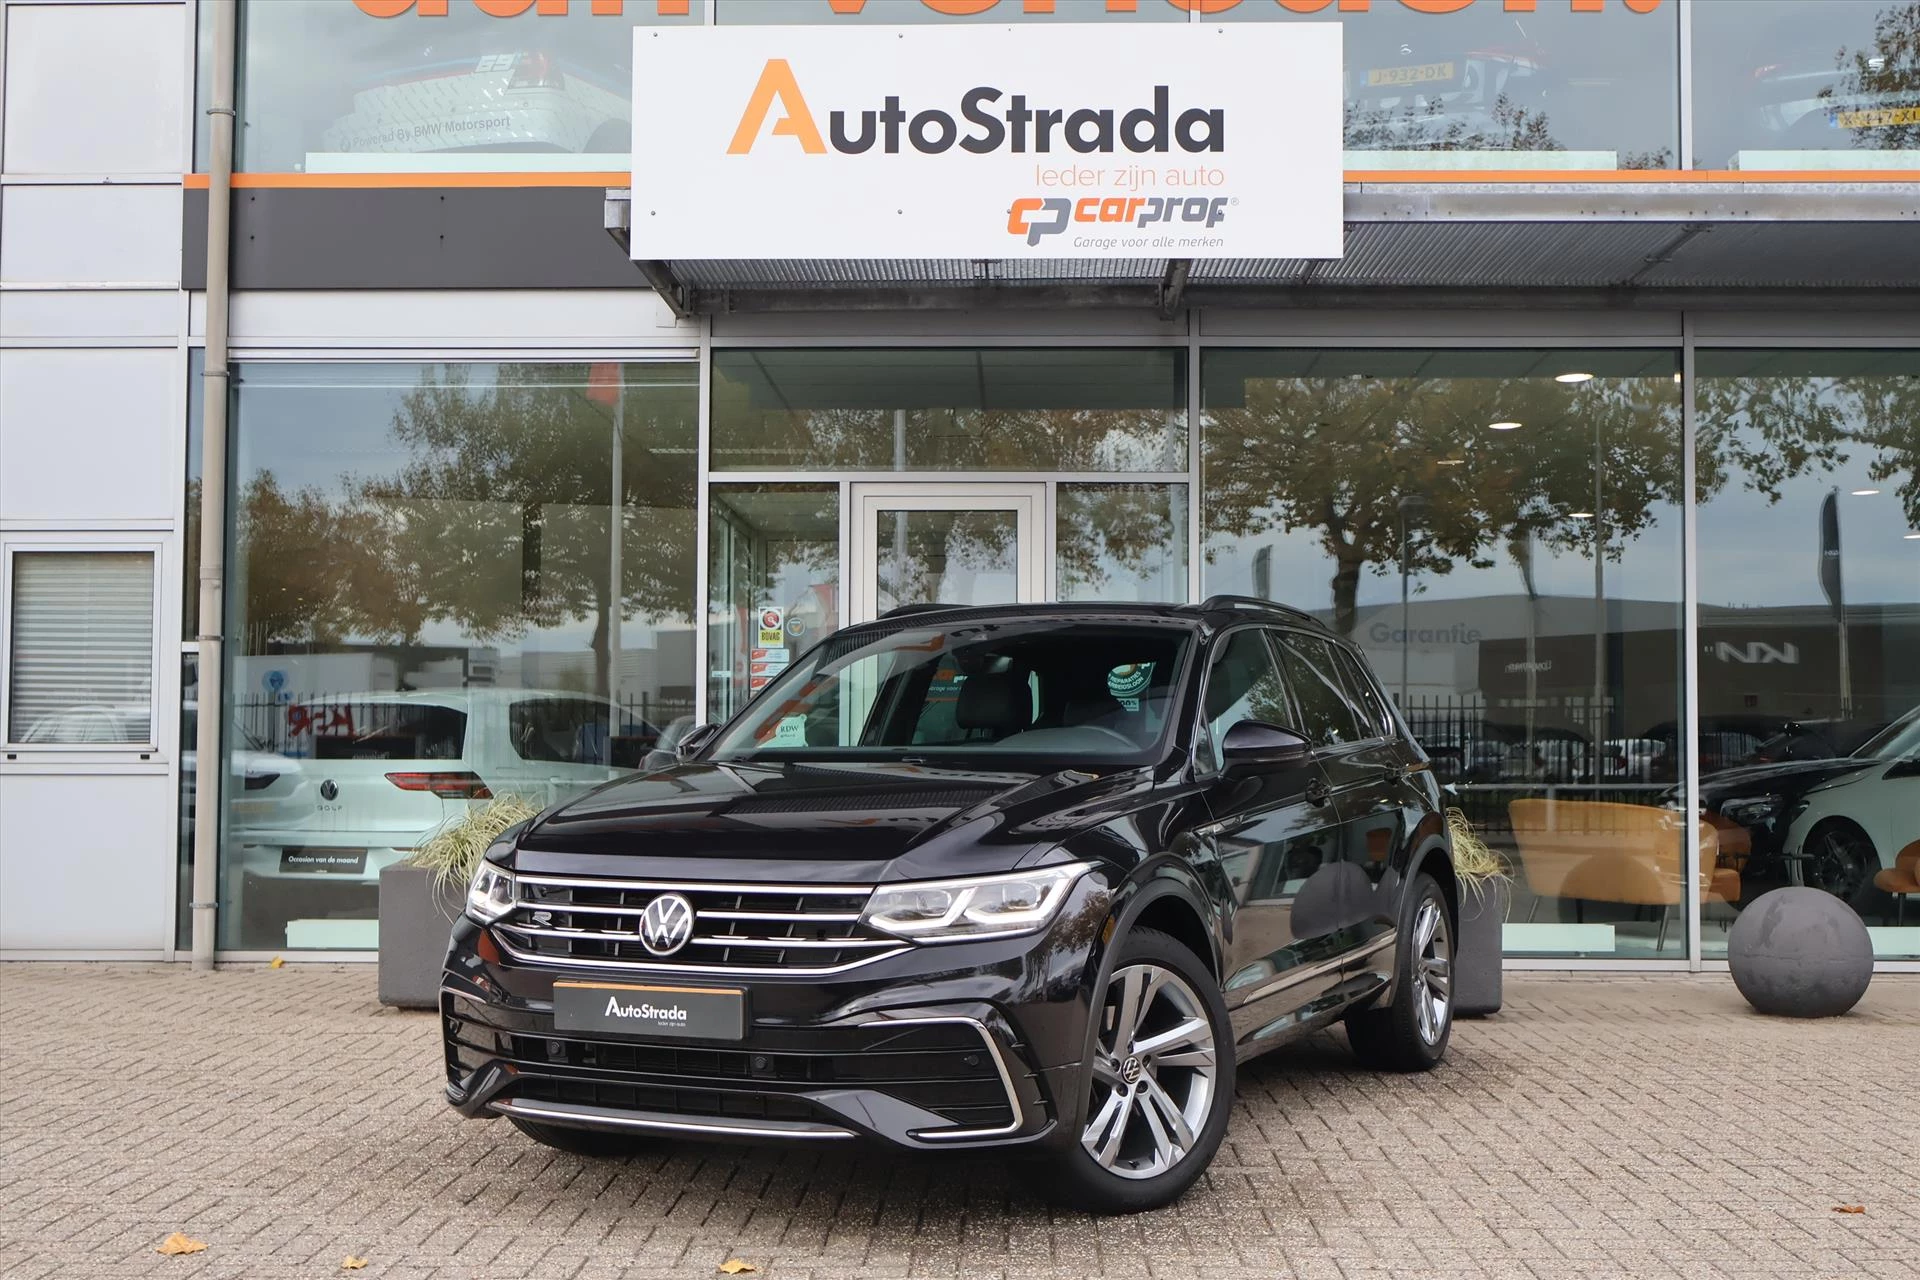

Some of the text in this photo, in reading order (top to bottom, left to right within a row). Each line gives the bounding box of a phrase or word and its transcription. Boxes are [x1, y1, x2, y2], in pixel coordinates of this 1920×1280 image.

[726, 58, 1225, 155] AutoStrada
[353, 115, 511, 147] Powered By BMW Motorsport
[1036, 164, 1225, 192] Ieder zijn auto
[1073, 236, 1225, 249] Garage voor alle merken
[761, 631, 780, 641] BOVAG
[1369, 622, 1482, 645] Garantie
[288, 855, 315, 863] Occasion
[336, 856, 359, 864] maand
[604, 995, 687, 1021] AutoStrada
